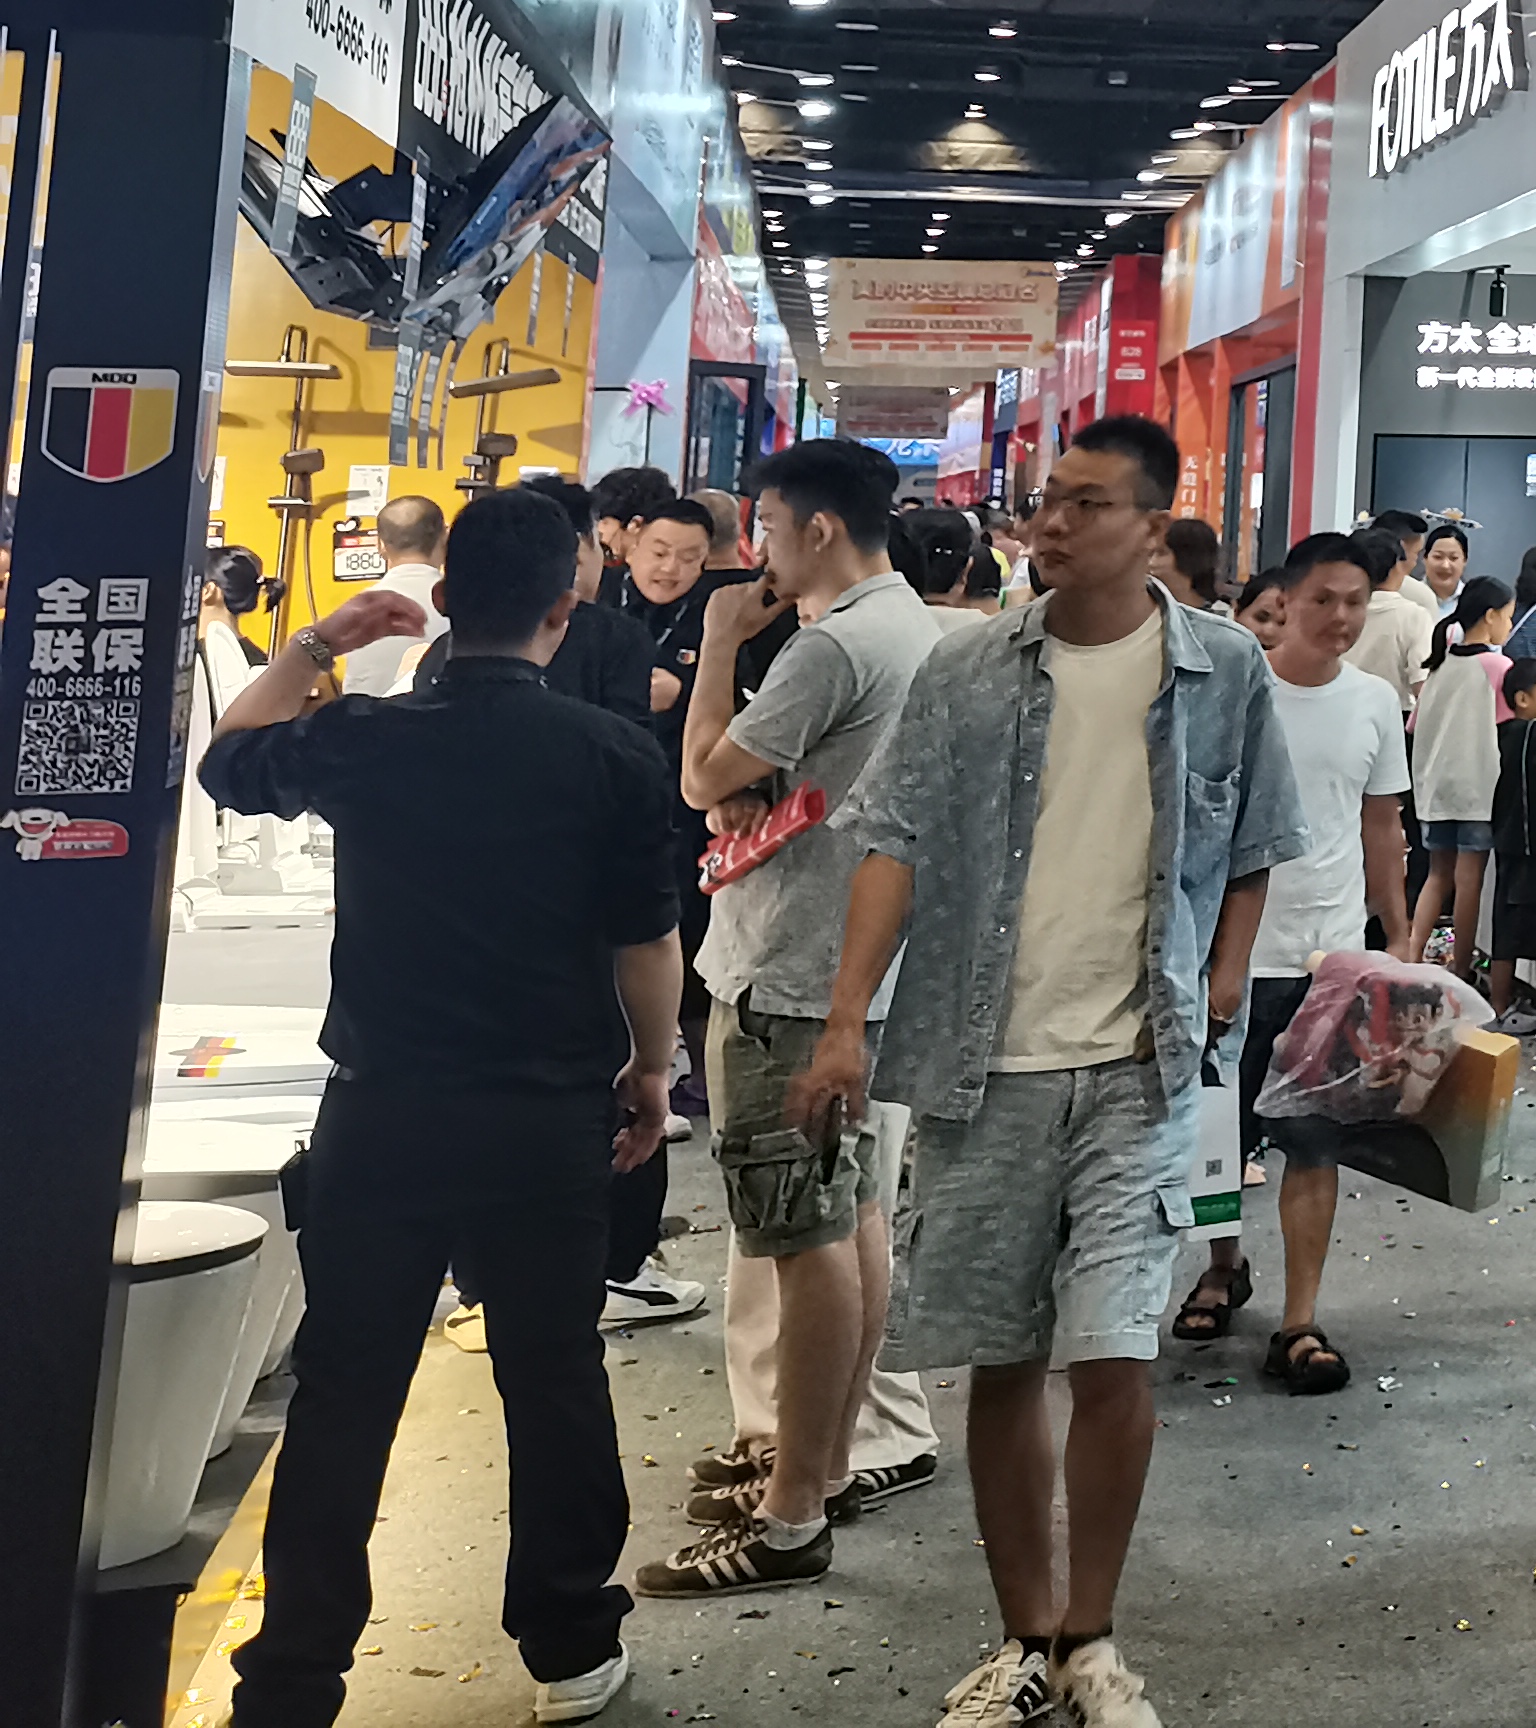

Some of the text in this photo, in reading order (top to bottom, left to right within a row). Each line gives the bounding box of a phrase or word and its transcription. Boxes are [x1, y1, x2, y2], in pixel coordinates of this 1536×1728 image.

[1368, 8, 1461, 177] FOTILE
[1417, 322, 1483, 355] 方太
[35, 577, 150, 623] 全国
[29, 627, 145, 675] 联保
[25, 675, 143, 698] 400-6666-116
